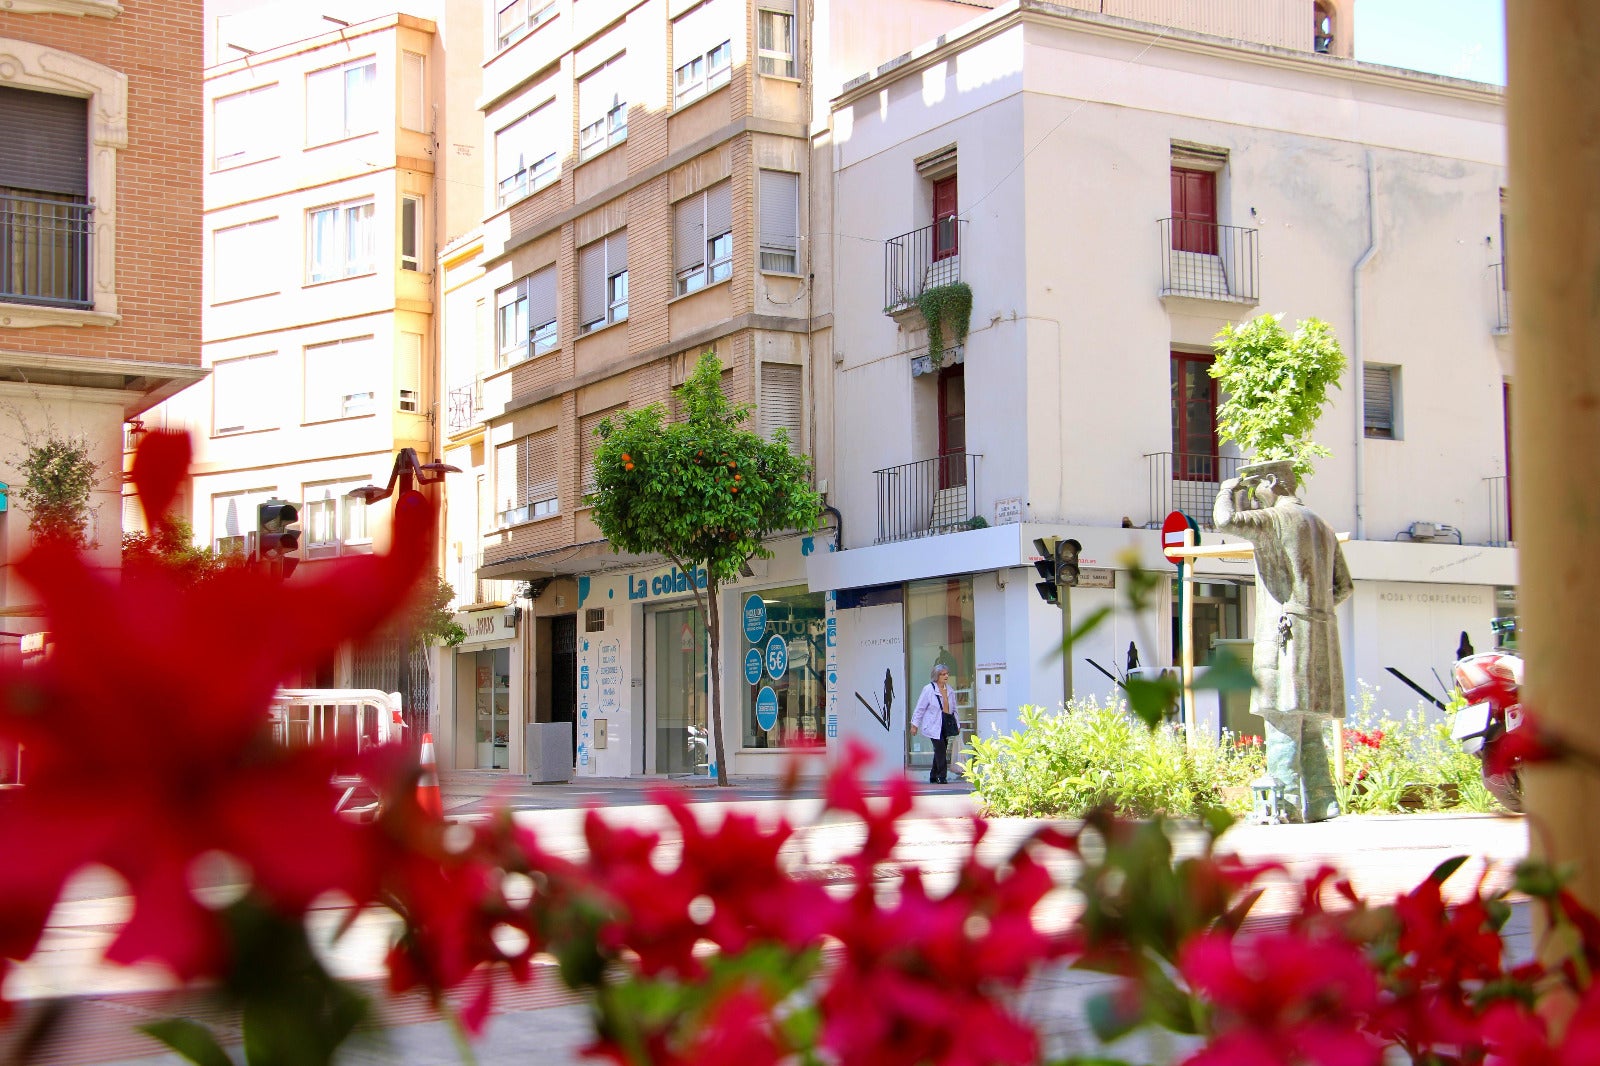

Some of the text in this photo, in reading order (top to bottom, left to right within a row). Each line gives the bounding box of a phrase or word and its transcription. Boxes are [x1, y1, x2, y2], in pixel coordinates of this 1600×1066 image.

[628, 564, 708, 600] La colada
[769, 651, 784, 670] 5€
